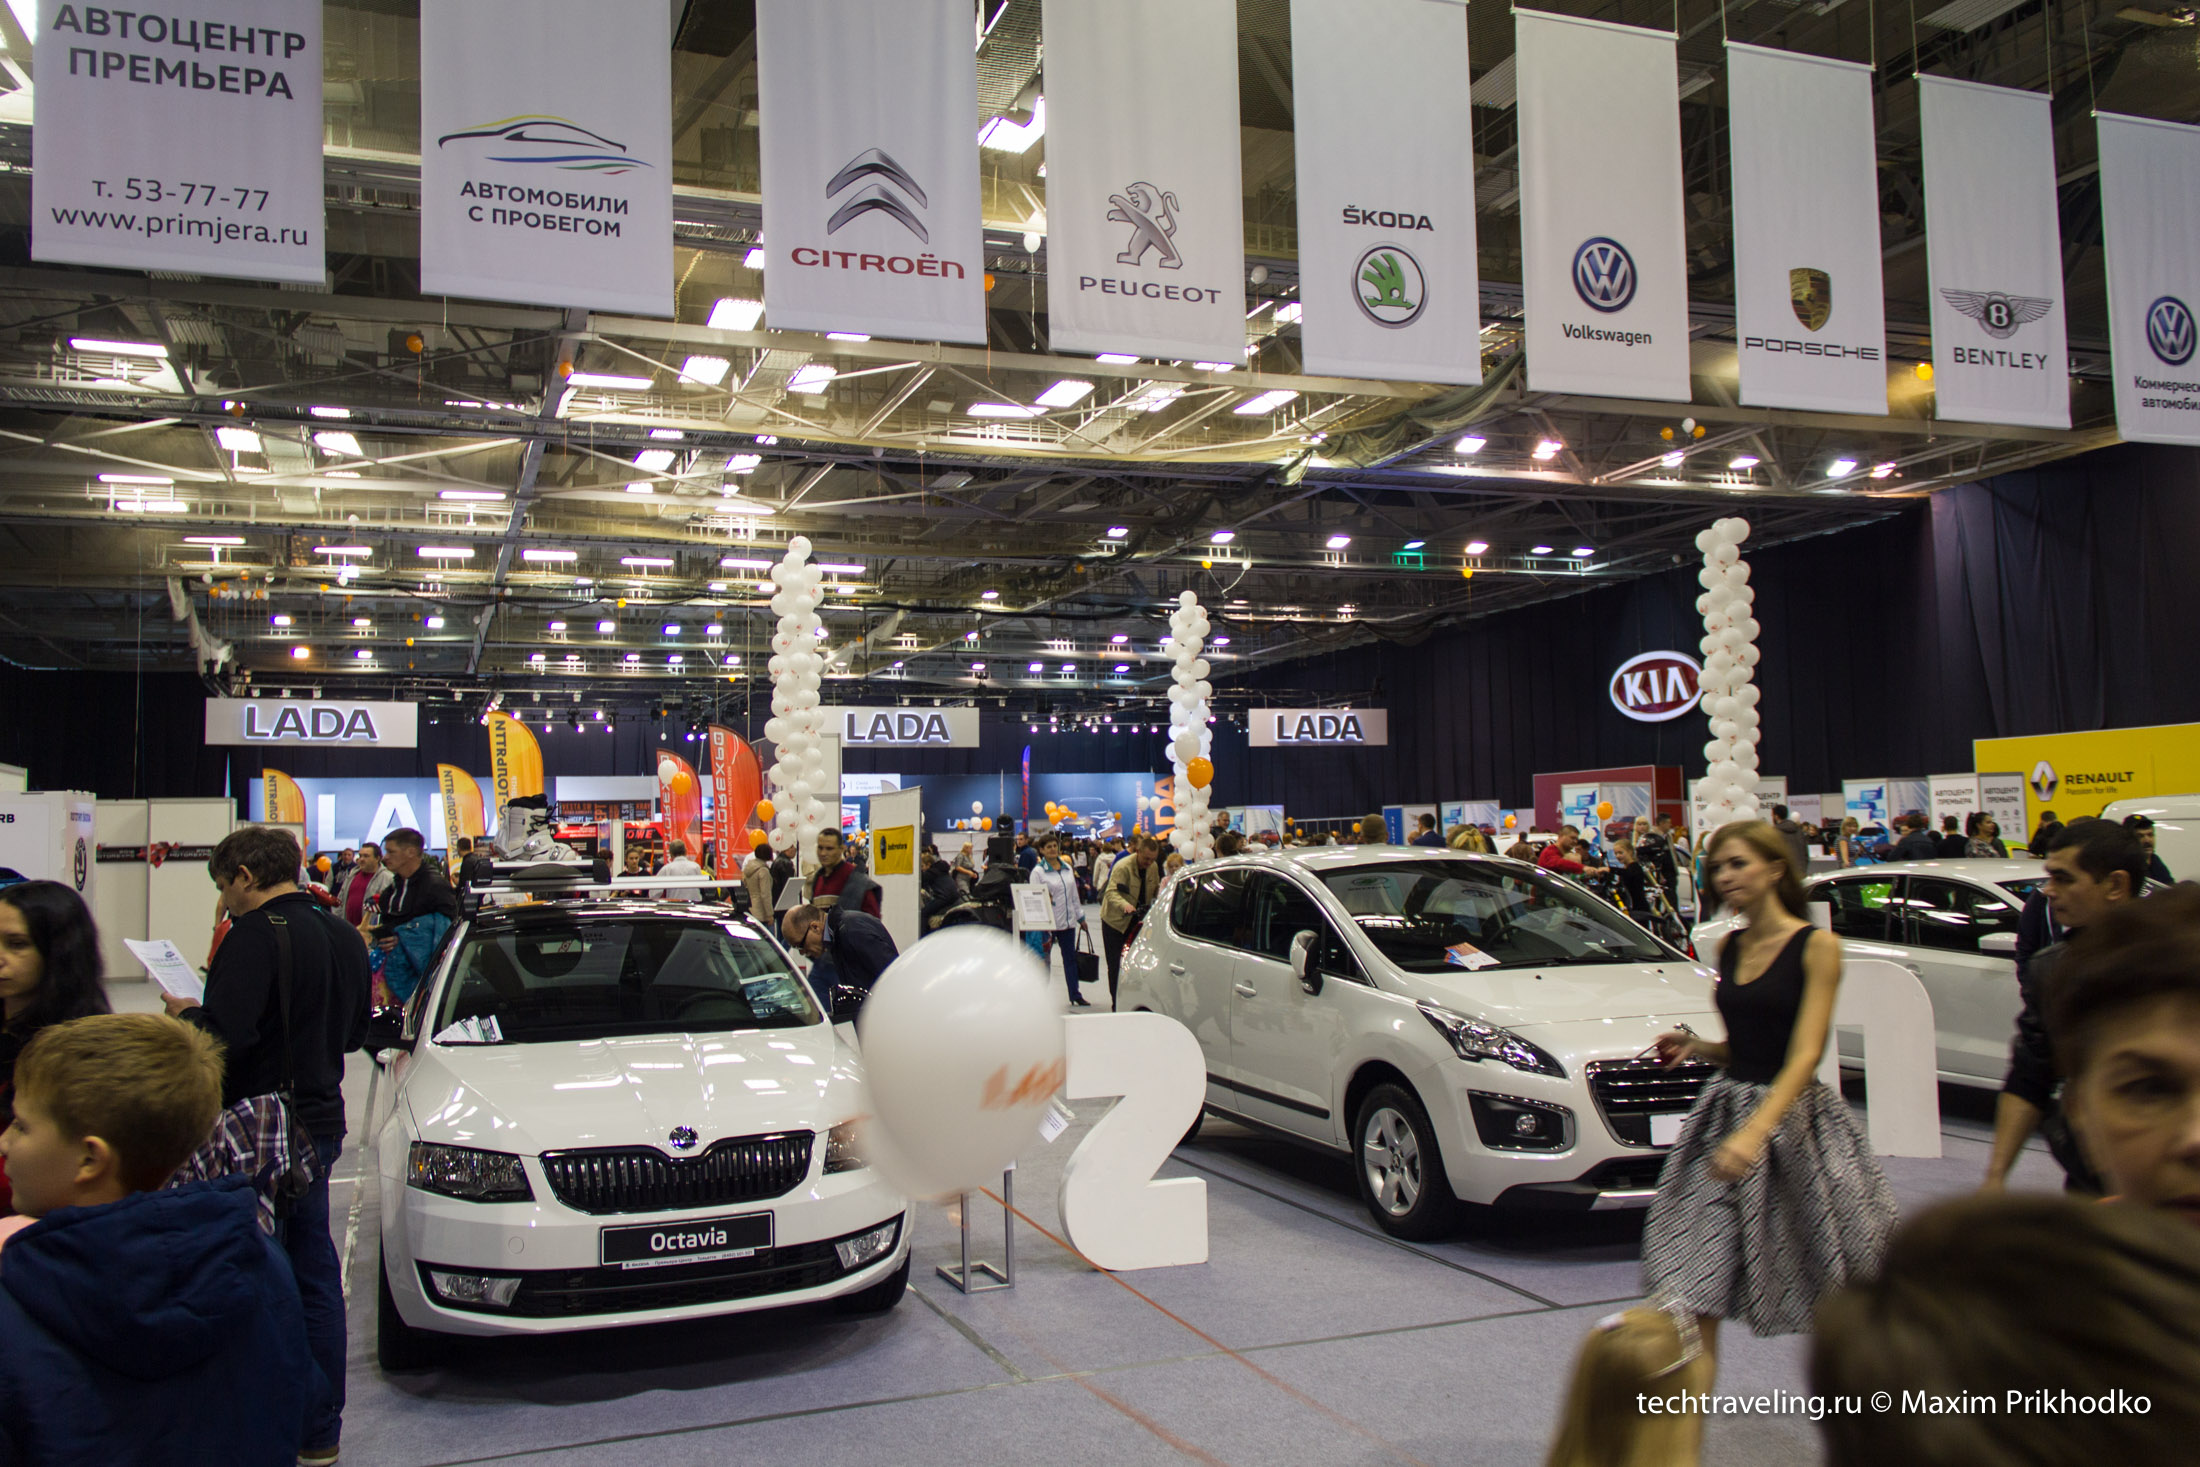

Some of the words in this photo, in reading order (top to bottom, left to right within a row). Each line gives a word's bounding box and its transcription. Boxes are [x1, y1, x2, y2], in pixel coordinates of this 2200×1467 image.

[53, 4, 306, 60] АВТОЦЕНТР
[69, 46, 295, 101] ПРЕМЬЕРА
[92, 179, 114, 199] т.
[125, 177, 270, 212] 53-77-77
[460, 180, 630, 216] АВТОМОБИЛИ
[51, 204, 309, 248] www.primjera.ru
[468, 205, 485, 222] С
[491, 205, 622, 239] ПРОБЕГОМ
[1342, 204, 1434, 232] ŠKODA
[1079, 275, 1222, 304] PEUGEOT
[1562, 323, 1652, 346] Volkswagen
[1744, 336, 1880, 361] PORSCHE
[1953, 346, 2048, 370] BENTLEY
[1622, 665, 1693, 709] KIA
[245, 706, 379, 741] LADA
[846, 712, 951, 742] LADA
[1276, 714, 1364, 741] LADA
[2065, 771, 2135, 785] RENAULT
[2065, 788, 2094, 796] Passion
[2095, 787, 2105, 795] for
[650, 1226, 728, 1252] Octavia
